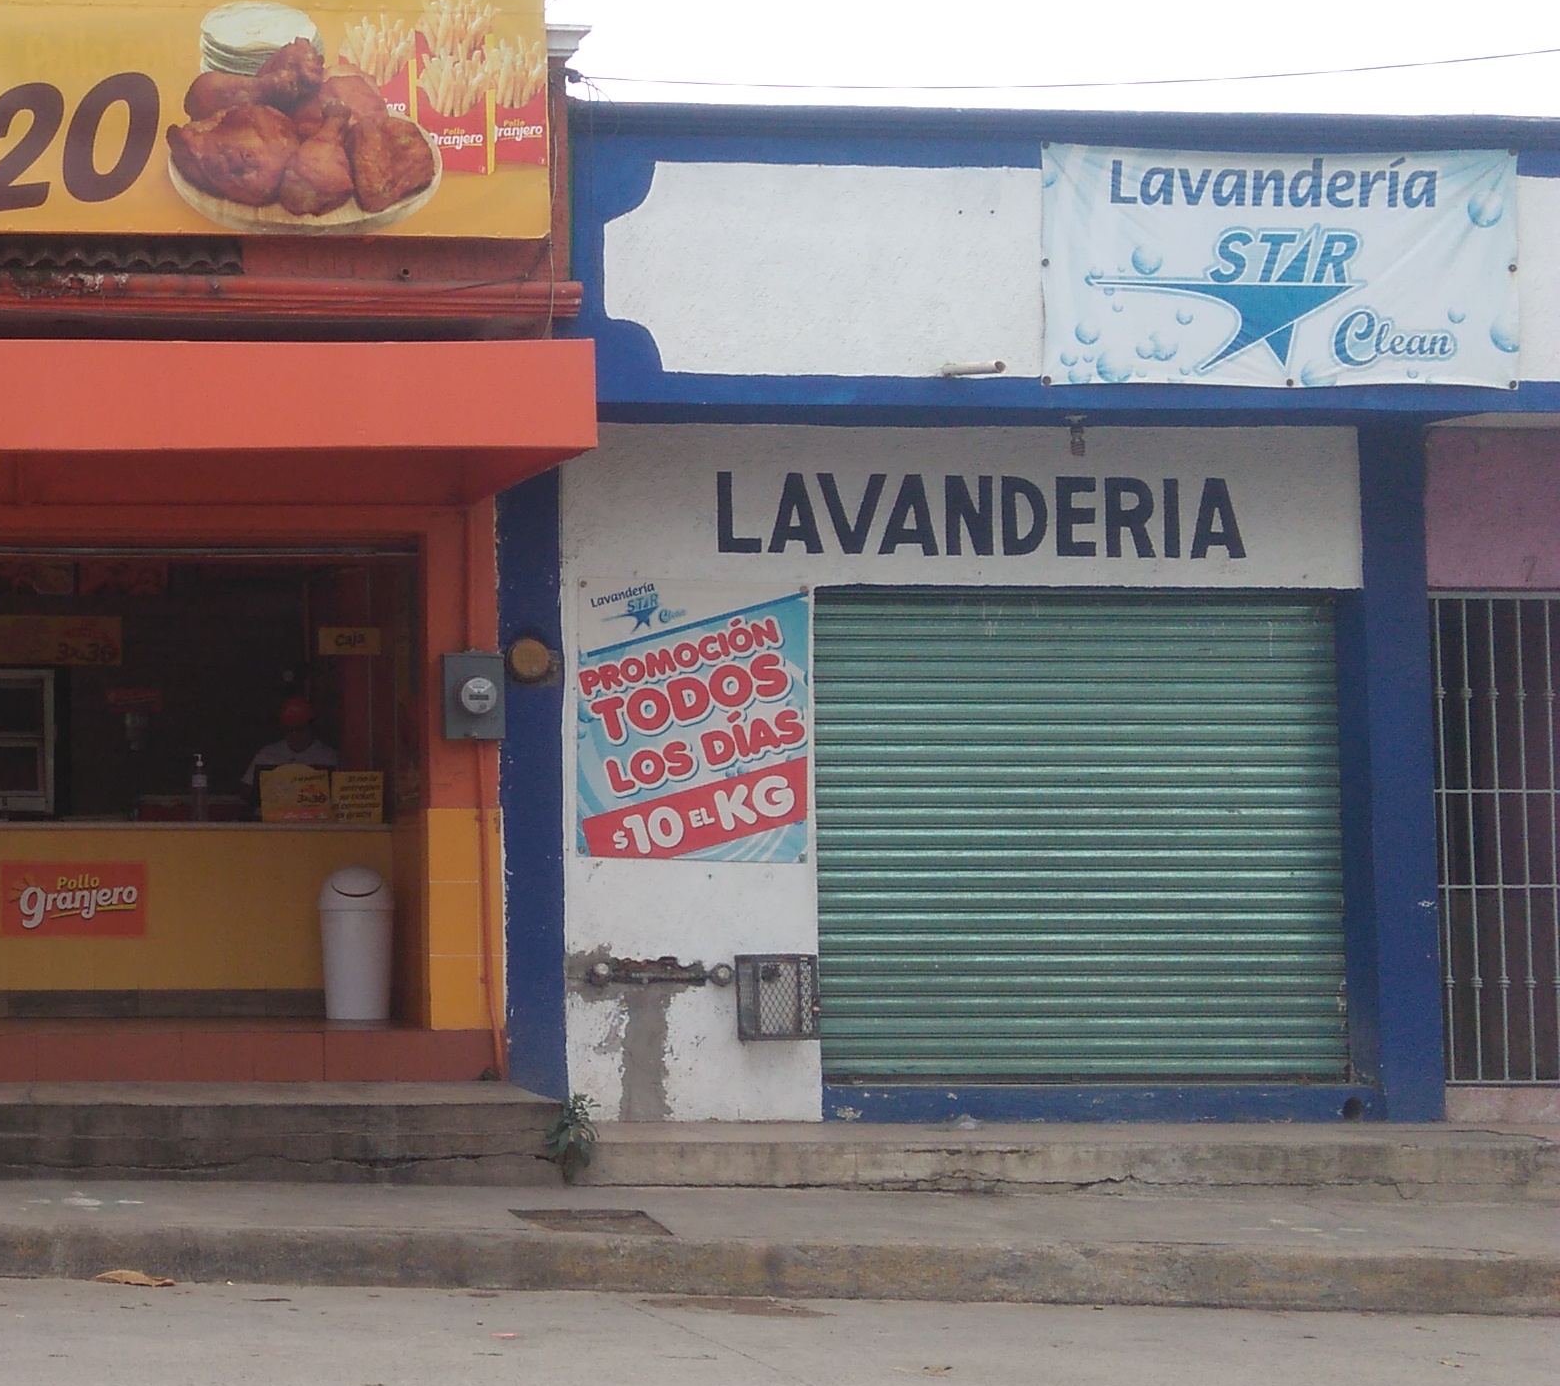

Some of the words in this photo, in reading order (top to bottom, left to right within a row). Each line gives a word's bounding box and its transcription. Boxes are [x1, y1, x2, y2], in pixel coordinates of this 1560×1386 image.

[1109, 157, 1438, 208] Lavandería
[1208, 225, 1361, 284] STAR
[1333, 310, 1453, 367] Clean
[716, 471, 1246, 559] LAVANDERIA
[590, 582, 655, 608] Lavandería
[335, 632, 365, 648] Caja
[579, 618, 780, 696] PROMOCIÓN
[591, 653, 788, 740] TODOS
[606, 741, 693, 793] LOS
[701, 710, 805, 766] DÍAS
[689, 808, 715, 828] EL
[714, 775, 795, 831] KG
[20, 886, 138, 929] granjero
[57, 874, 100, 890] Pollo
